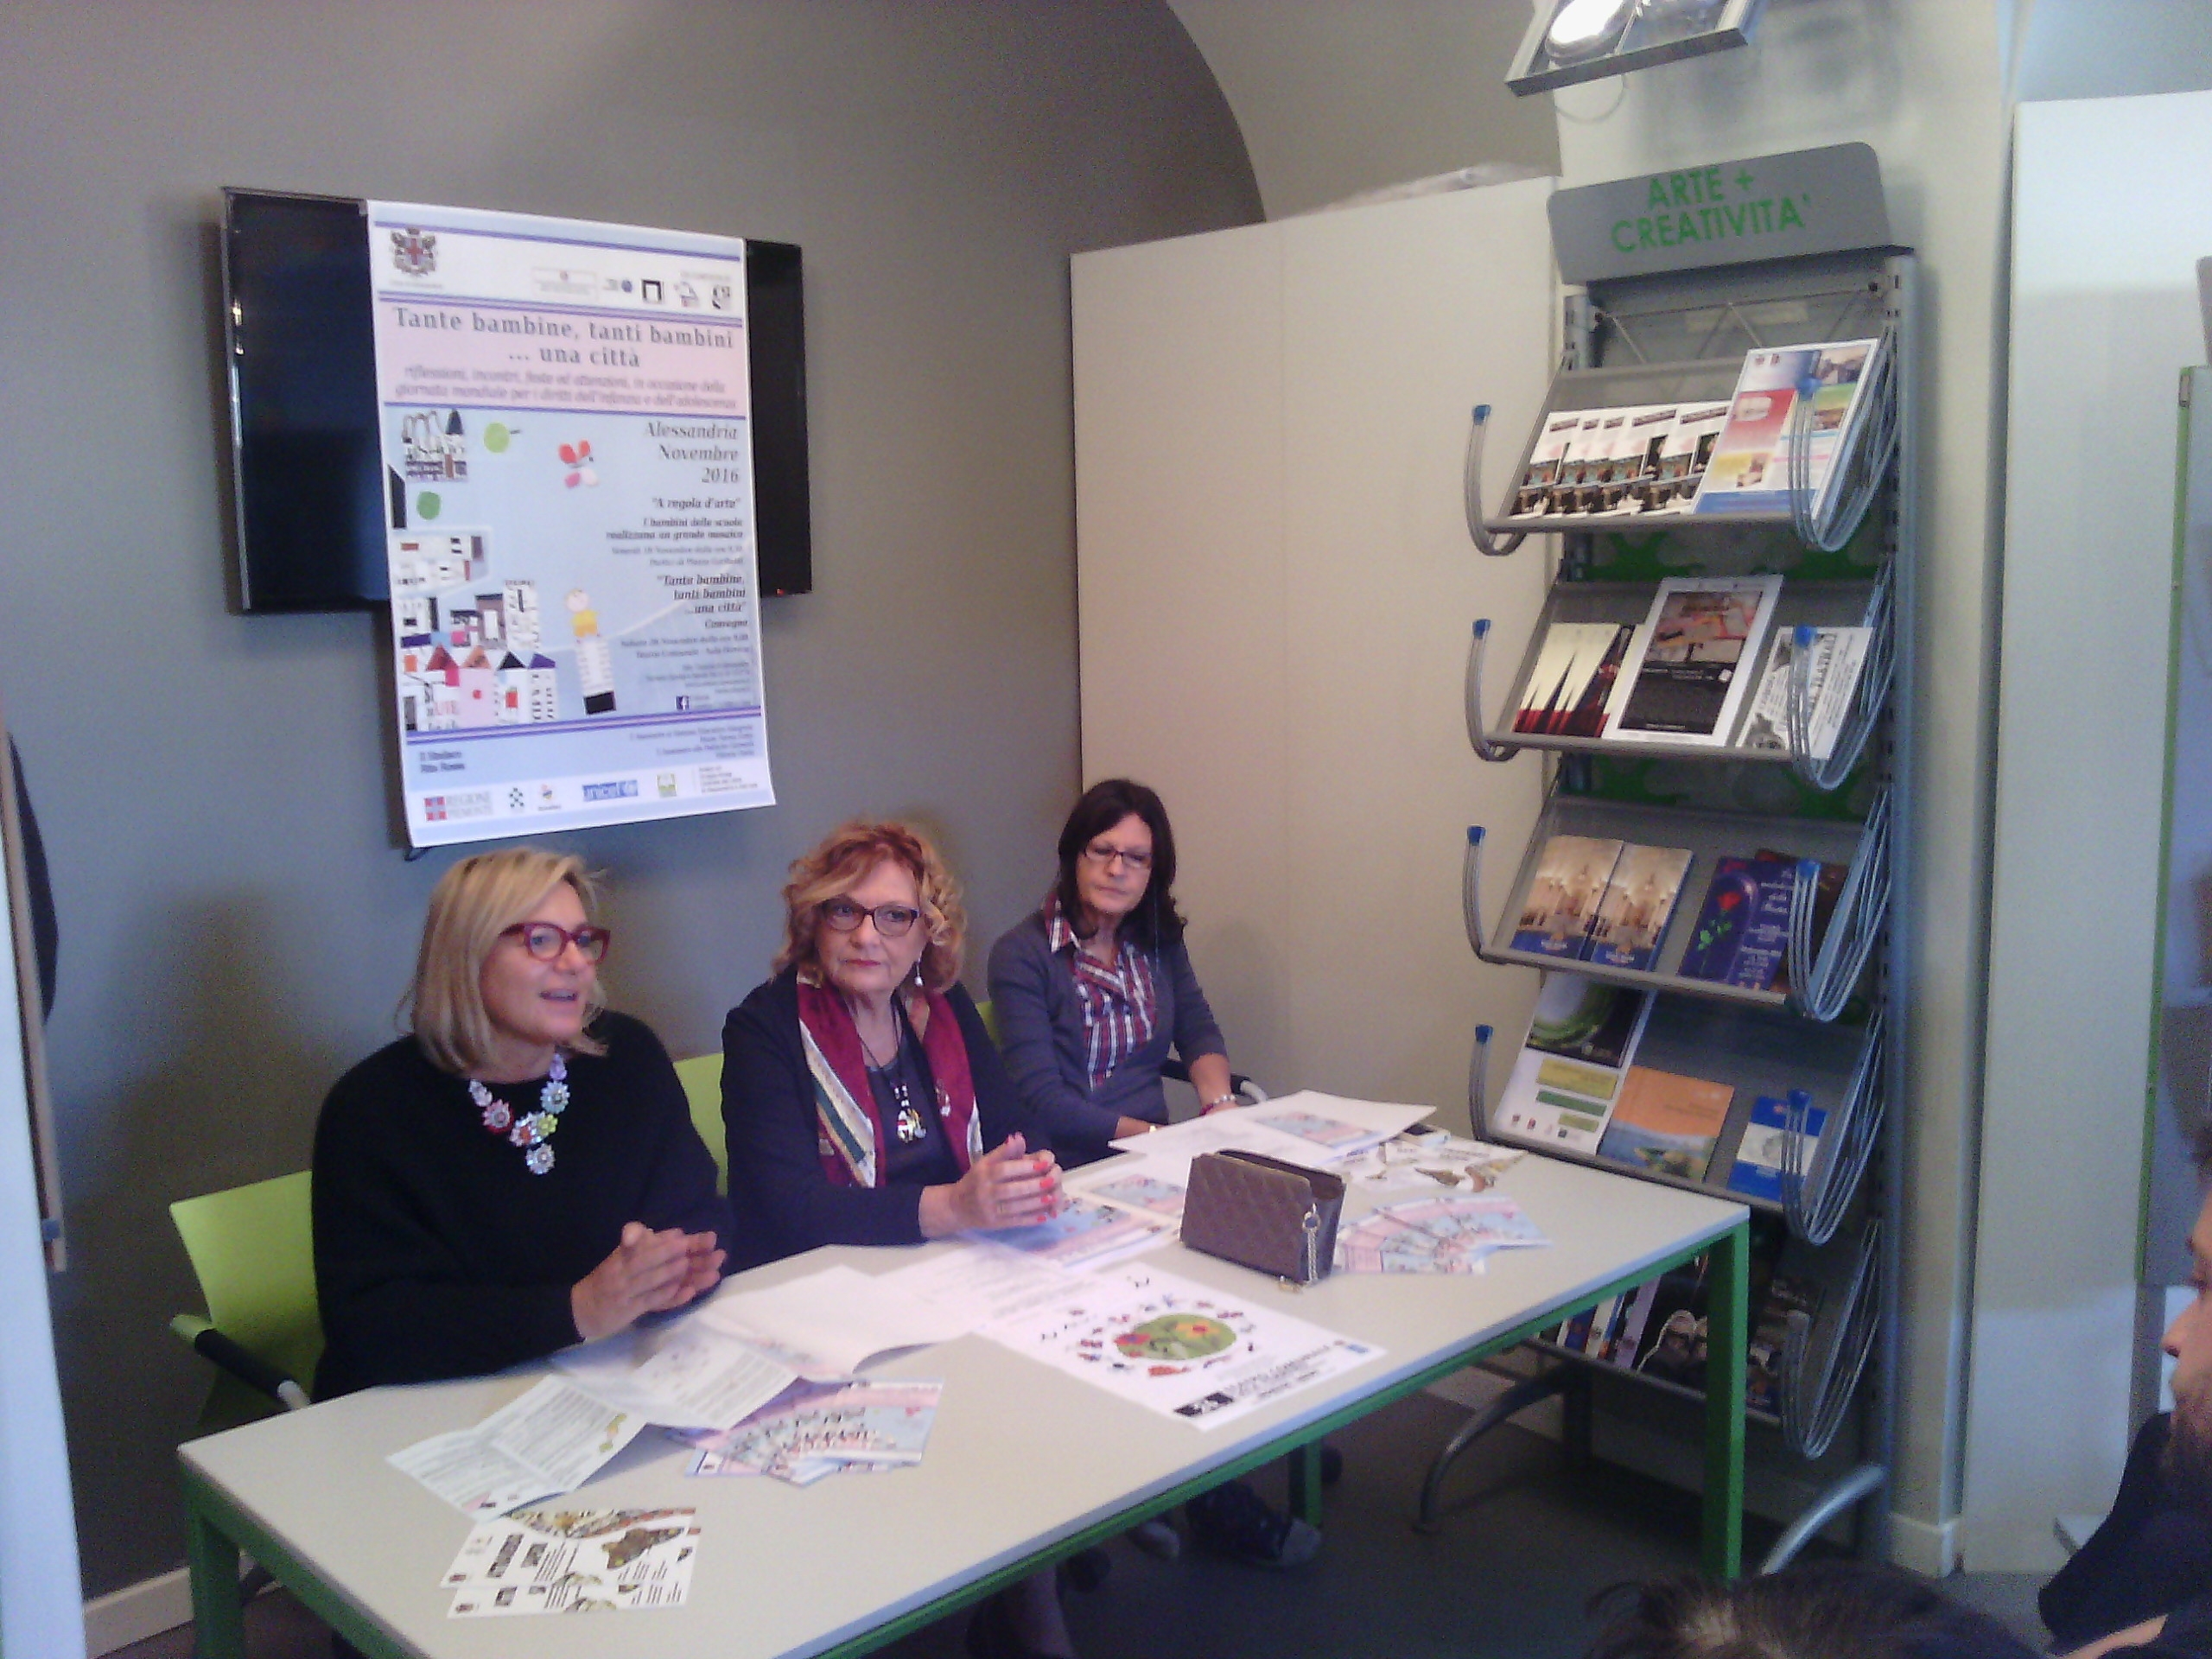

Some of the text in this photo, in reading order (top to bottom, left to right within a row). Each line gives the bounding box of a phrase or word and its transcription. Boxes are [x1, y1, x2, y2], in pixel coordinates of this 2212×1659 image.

[1647, 168, 1725, 211] ARTE
[1611, 193, 1812, 253] CREATIVITA'
[397, 307, 734, 348] Tante bambine, tanti bambini
[539, 347, 580, 364] una
[589, 346, 640, 367] città
[646, 421, 738, 440] Alessandria
[658, 444, 738, 461] Novembre
[701, 467, 739, 483] 2016
[667, 498, 701, 510] regola
[650, 518, 688, 527] bambini
[674, 588, 746, 601] tanti bambini
[704, 619, 748, 629] Convegno
